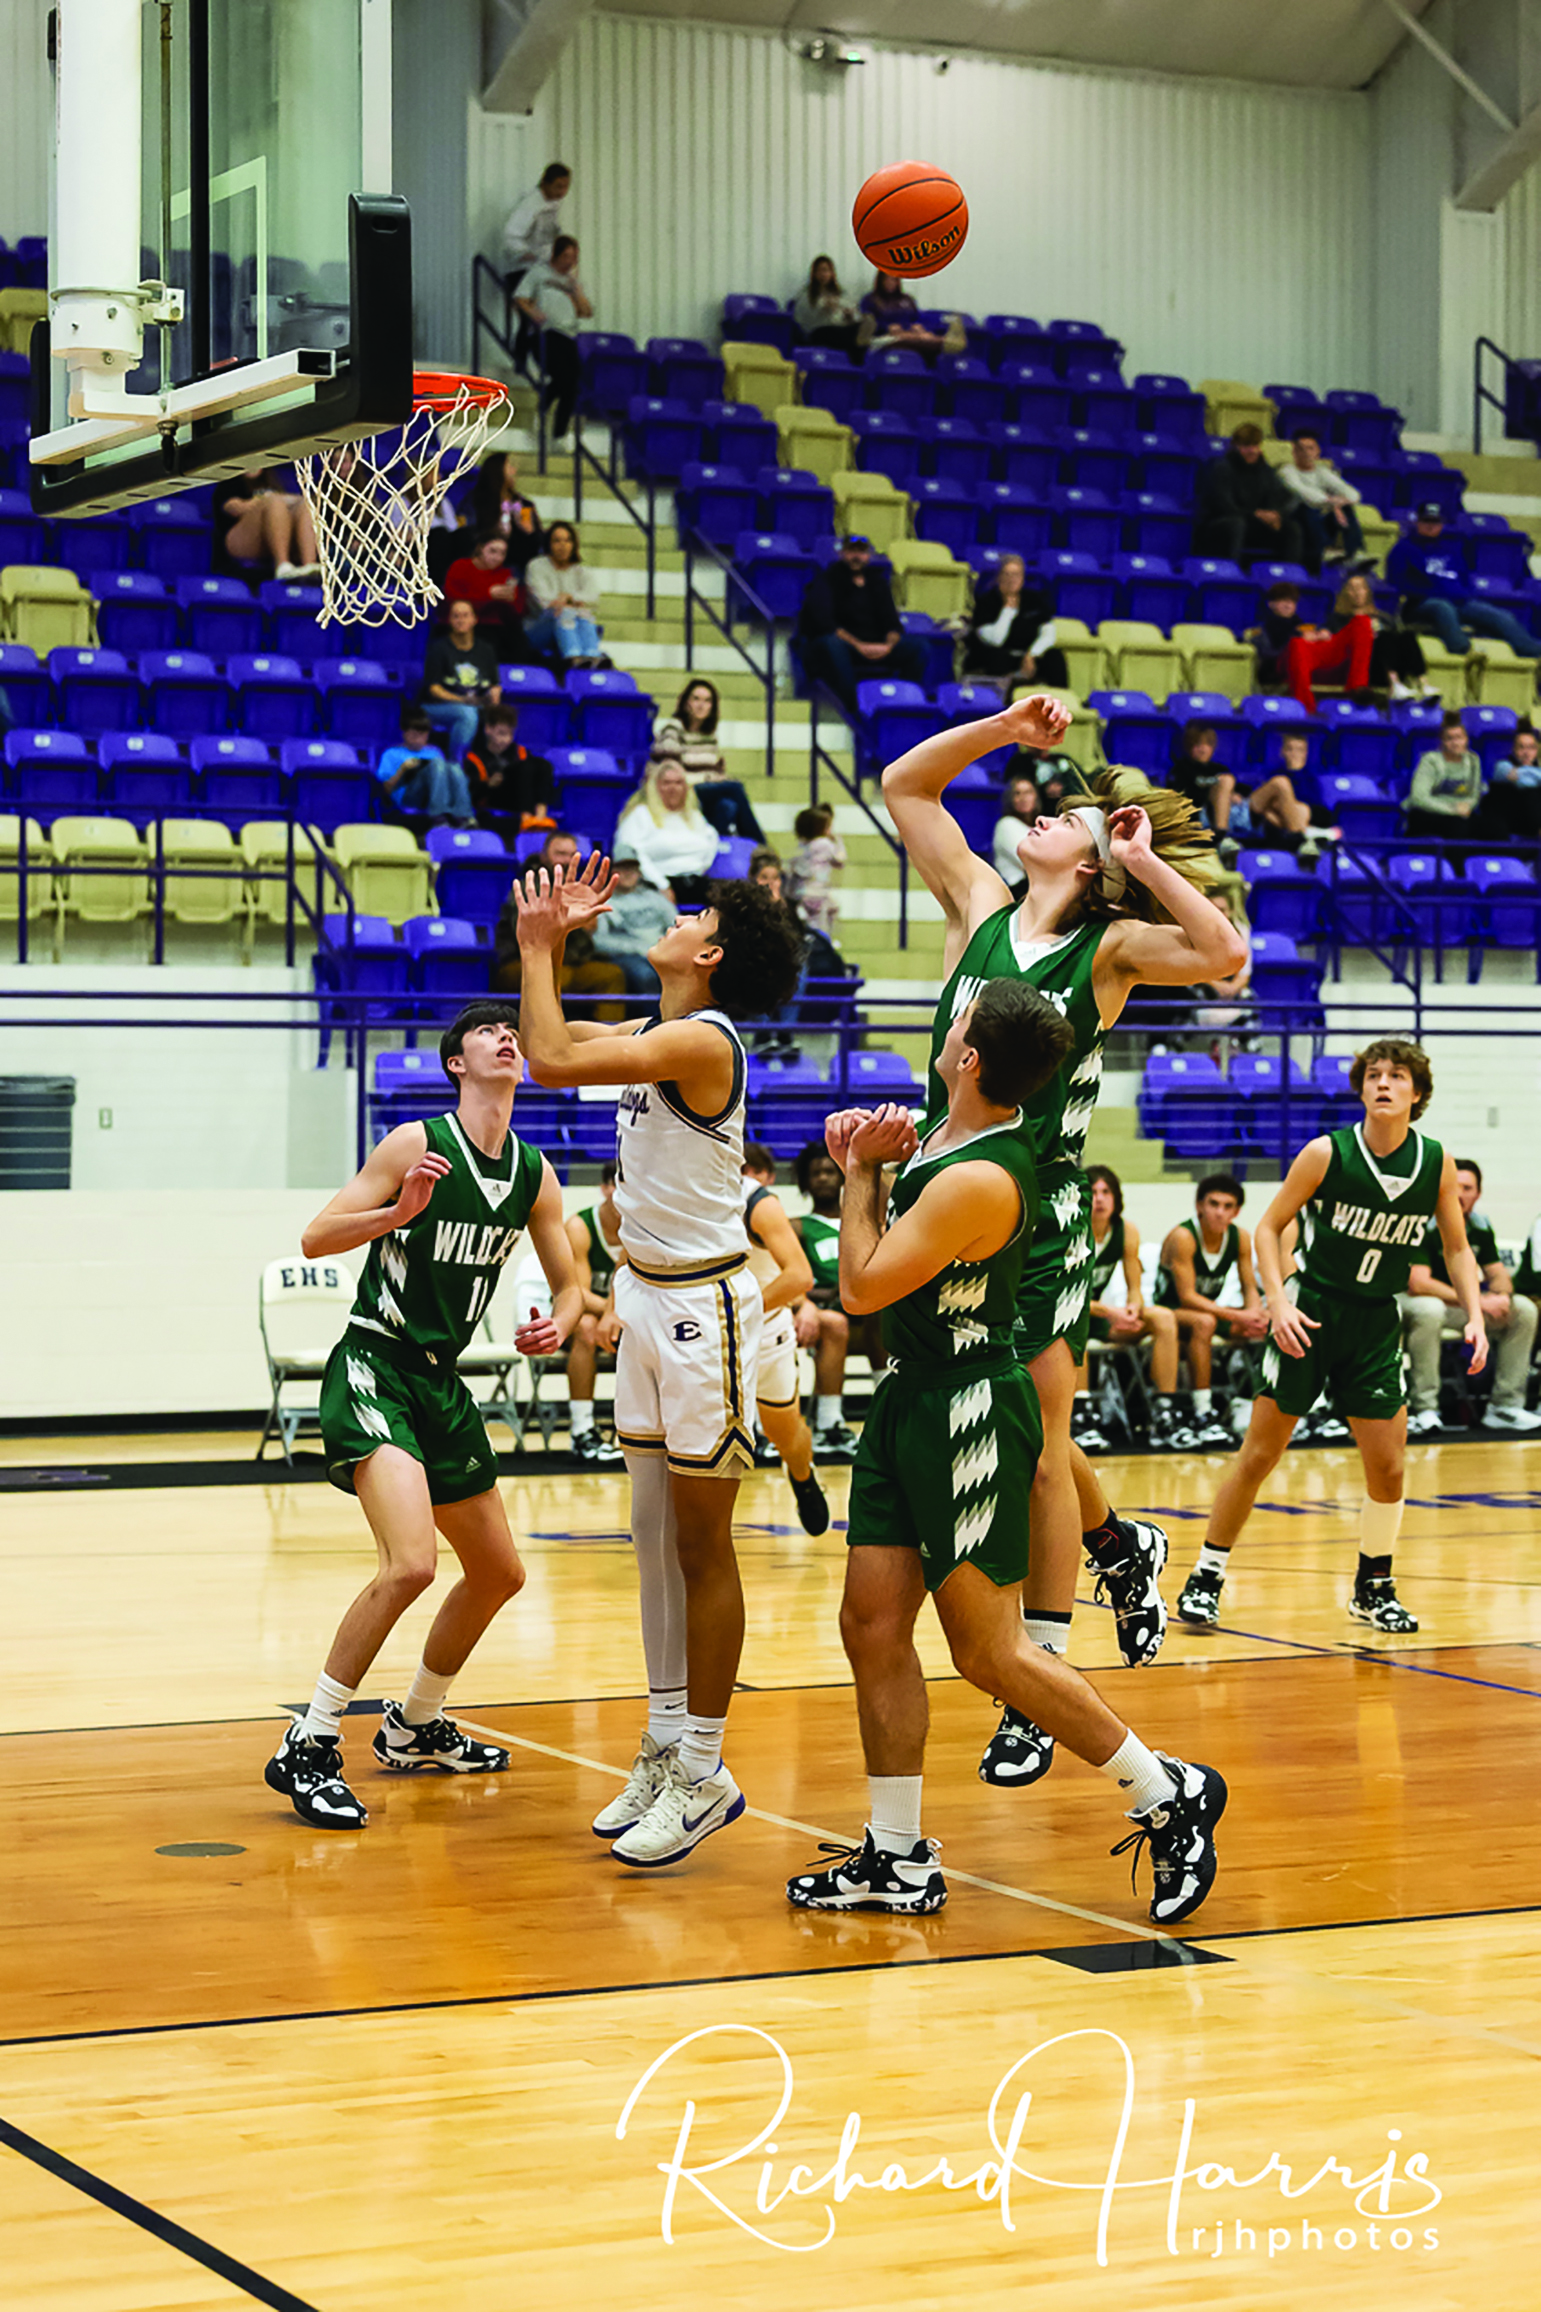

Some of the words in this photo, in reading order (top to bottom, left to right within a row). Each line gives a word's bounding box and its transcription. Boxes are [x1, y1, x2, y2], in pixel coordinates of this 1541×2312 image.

[888, 226, 961, 265] Wilson
[1331, 1202, 1429, 1247] WILDCATS
[281, 1266, 339, 1288] EHS
[673, 1320, 702, 1342] E
